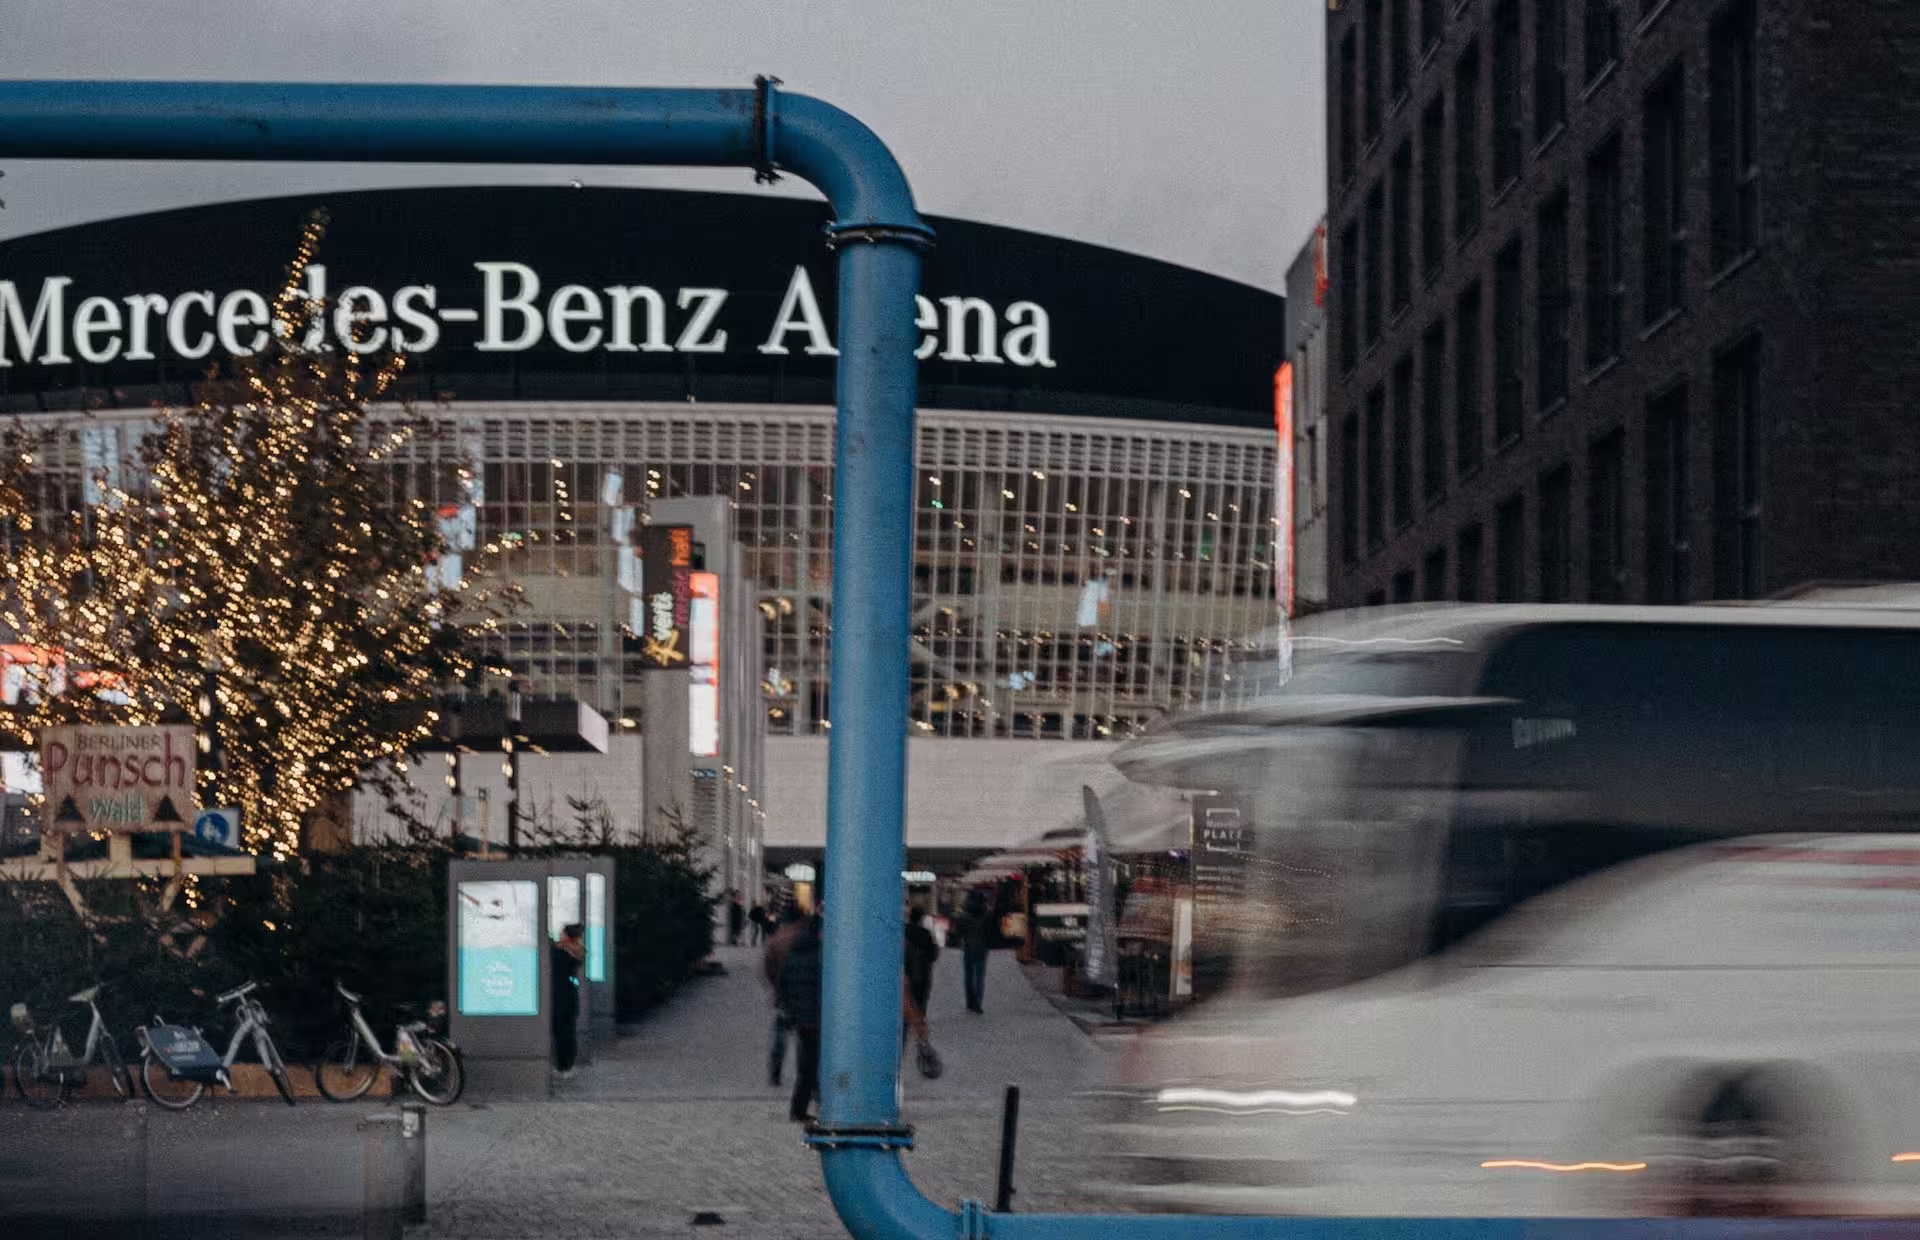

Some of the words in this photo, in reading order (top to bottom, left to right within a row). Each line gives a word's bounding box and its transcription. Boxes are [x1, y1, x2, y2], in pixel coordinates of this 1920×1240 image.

[0, 260, 729, 367] Mercedes-Benz
[45, 732, 186, 788] Punsch
[77, 733, 162, 749] BERLINER
